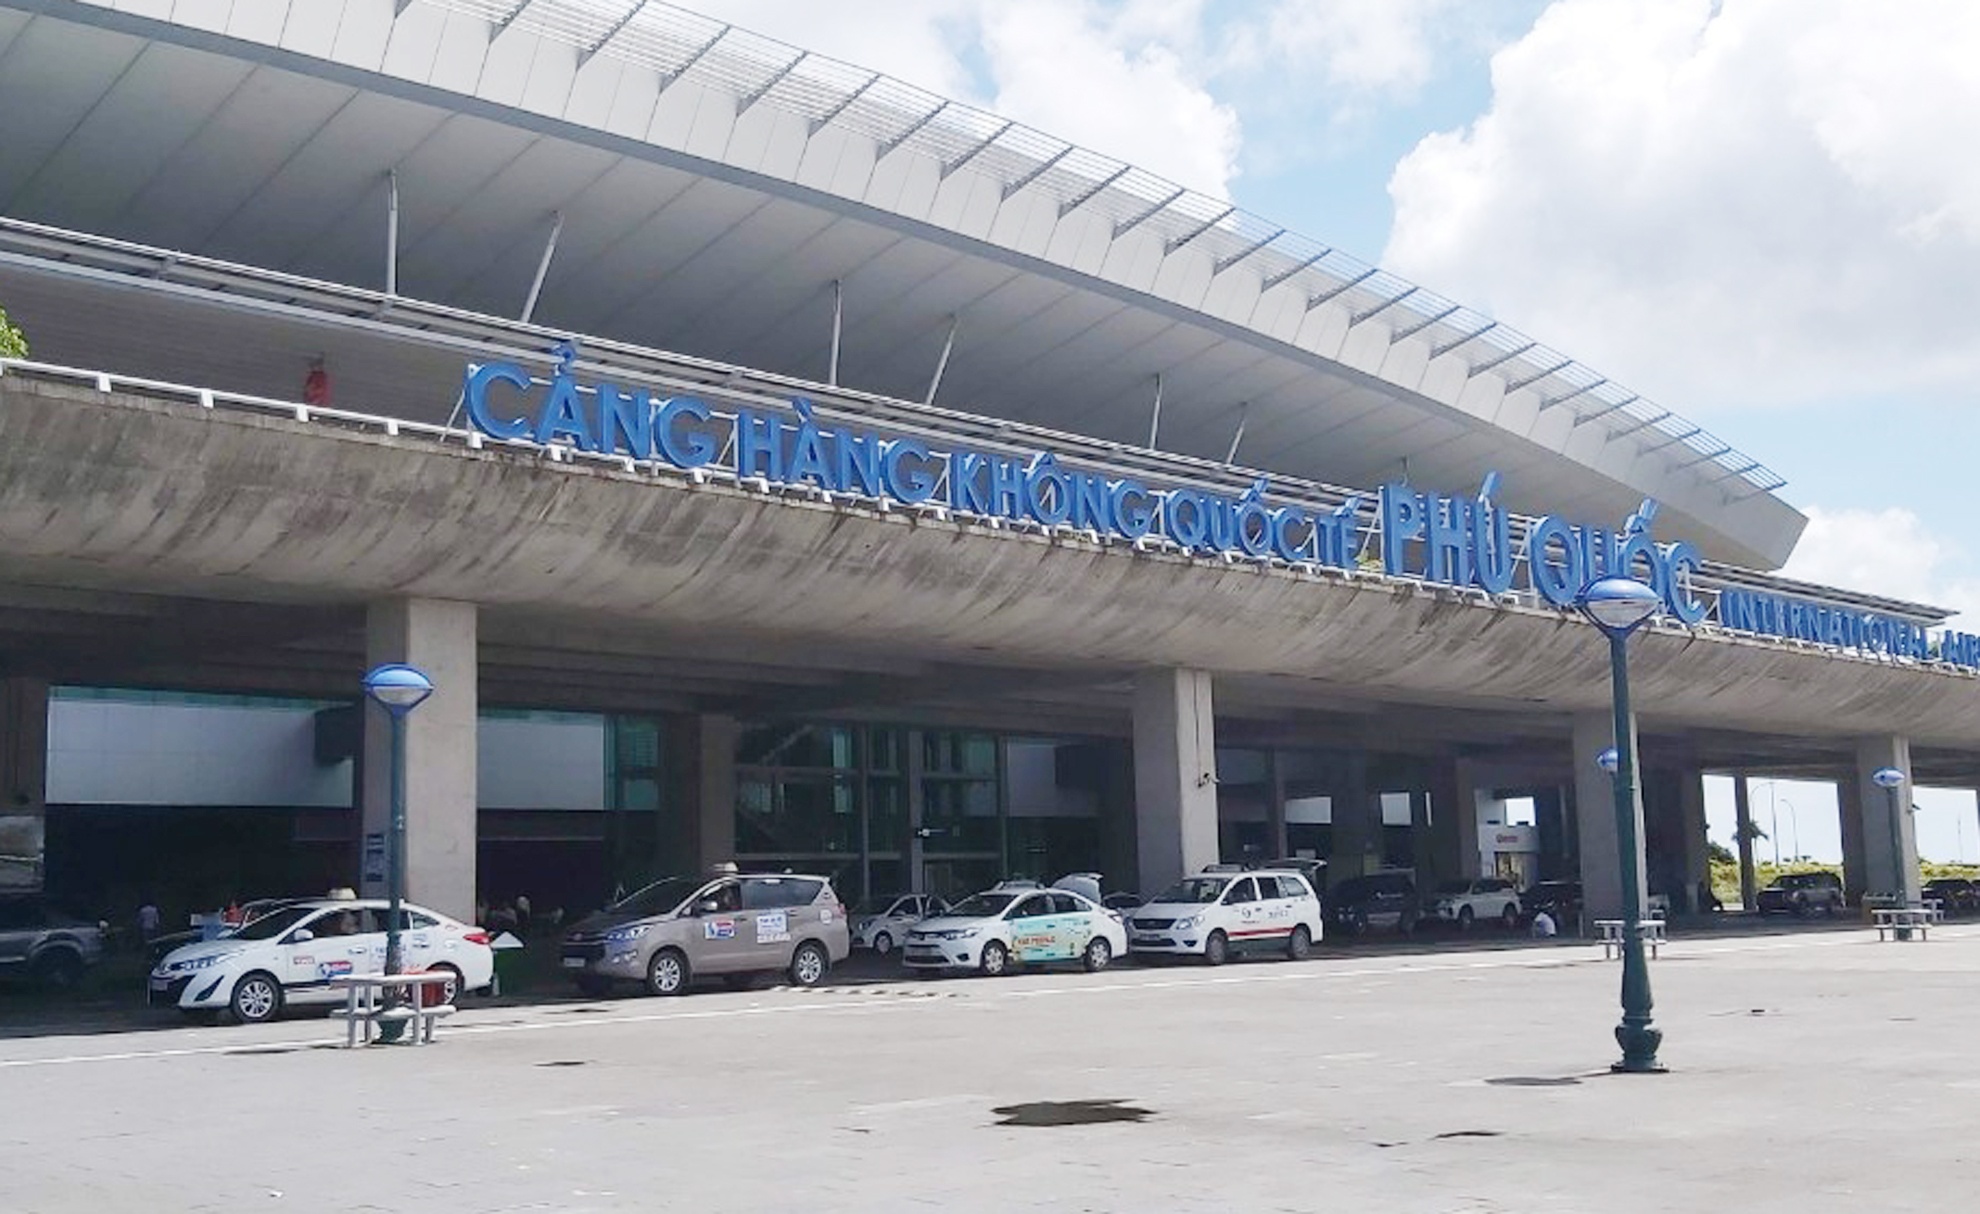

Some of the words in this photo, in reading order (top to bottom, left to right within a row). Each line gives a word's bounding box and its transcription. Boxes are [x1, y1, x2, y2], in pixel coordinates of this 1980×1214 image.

[465, 339, 717, 469] CẢNG
[738, 396, 936, 503] HÀNG
[950, 449, 1152, 540] KHÔNG
[1166, 477, 1310, 562] QUỐC
[1316, 497, 1363, 569] TẾ
[1383, 469, 1513, 593] PHÚ
[1721, 587, 1935, 660] INTERNATIONAL
